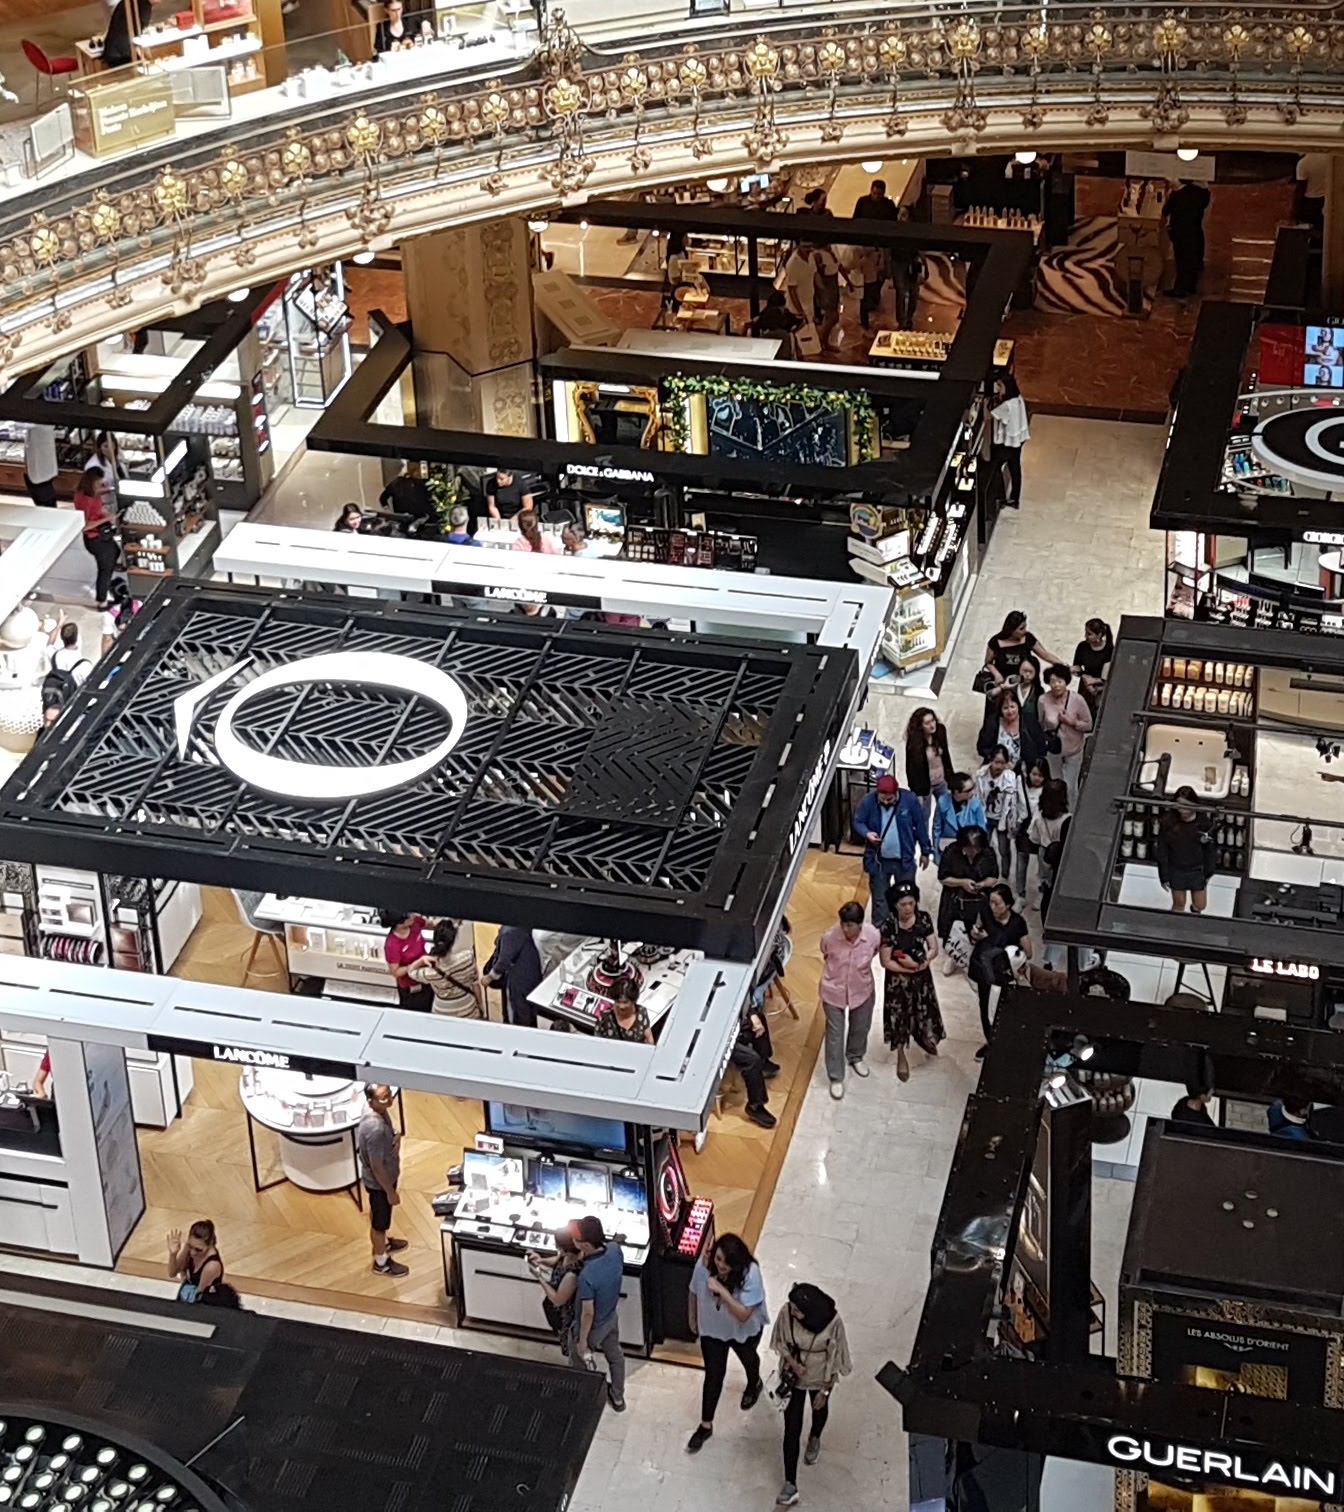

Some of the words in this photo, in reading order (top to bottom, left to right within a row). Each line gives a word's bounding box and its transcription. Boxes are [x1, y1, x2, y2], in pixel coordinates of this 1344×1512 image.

[1251, 958, 1274, 976] LE
[1276, 960, 1320, 980] LABO
[1187, 1328, 1202, 1337] LES
[1204, 1331, 1245, 1344] ABSOLUS
[1106, 1435, 1336, 1495] GUERLAIN
